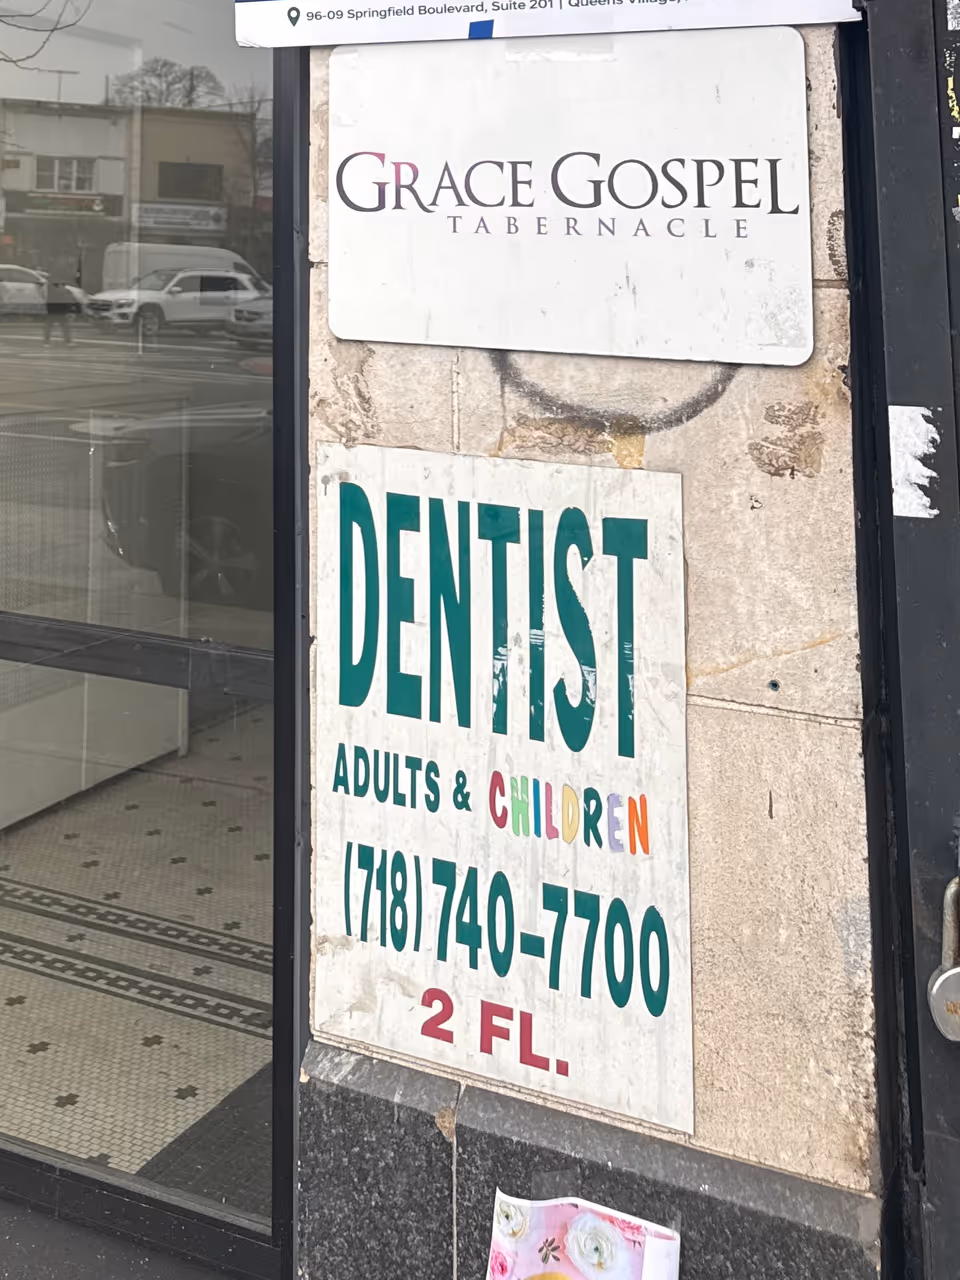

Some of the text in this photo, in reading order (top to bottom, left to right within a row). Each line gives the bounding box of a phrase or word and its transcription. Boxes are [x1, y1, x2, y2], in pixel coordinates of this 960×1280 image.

[306, 10, 344, 21] 96-09
[347, 5, 415, 20] Springfield
[418, 1, 488, 16] Boulevard,
[491, 0, 526, 12] Suite
[335, 151, 801, 215] GRACE GOSPEL
[446, 214, 750, 239] TABERNACLE
[339, 481, 649, 759] DENTIST
[332, 742, 650, 856] ADULTS & CHILDREN
[420, 987, 569, 1077] 2 FL.
